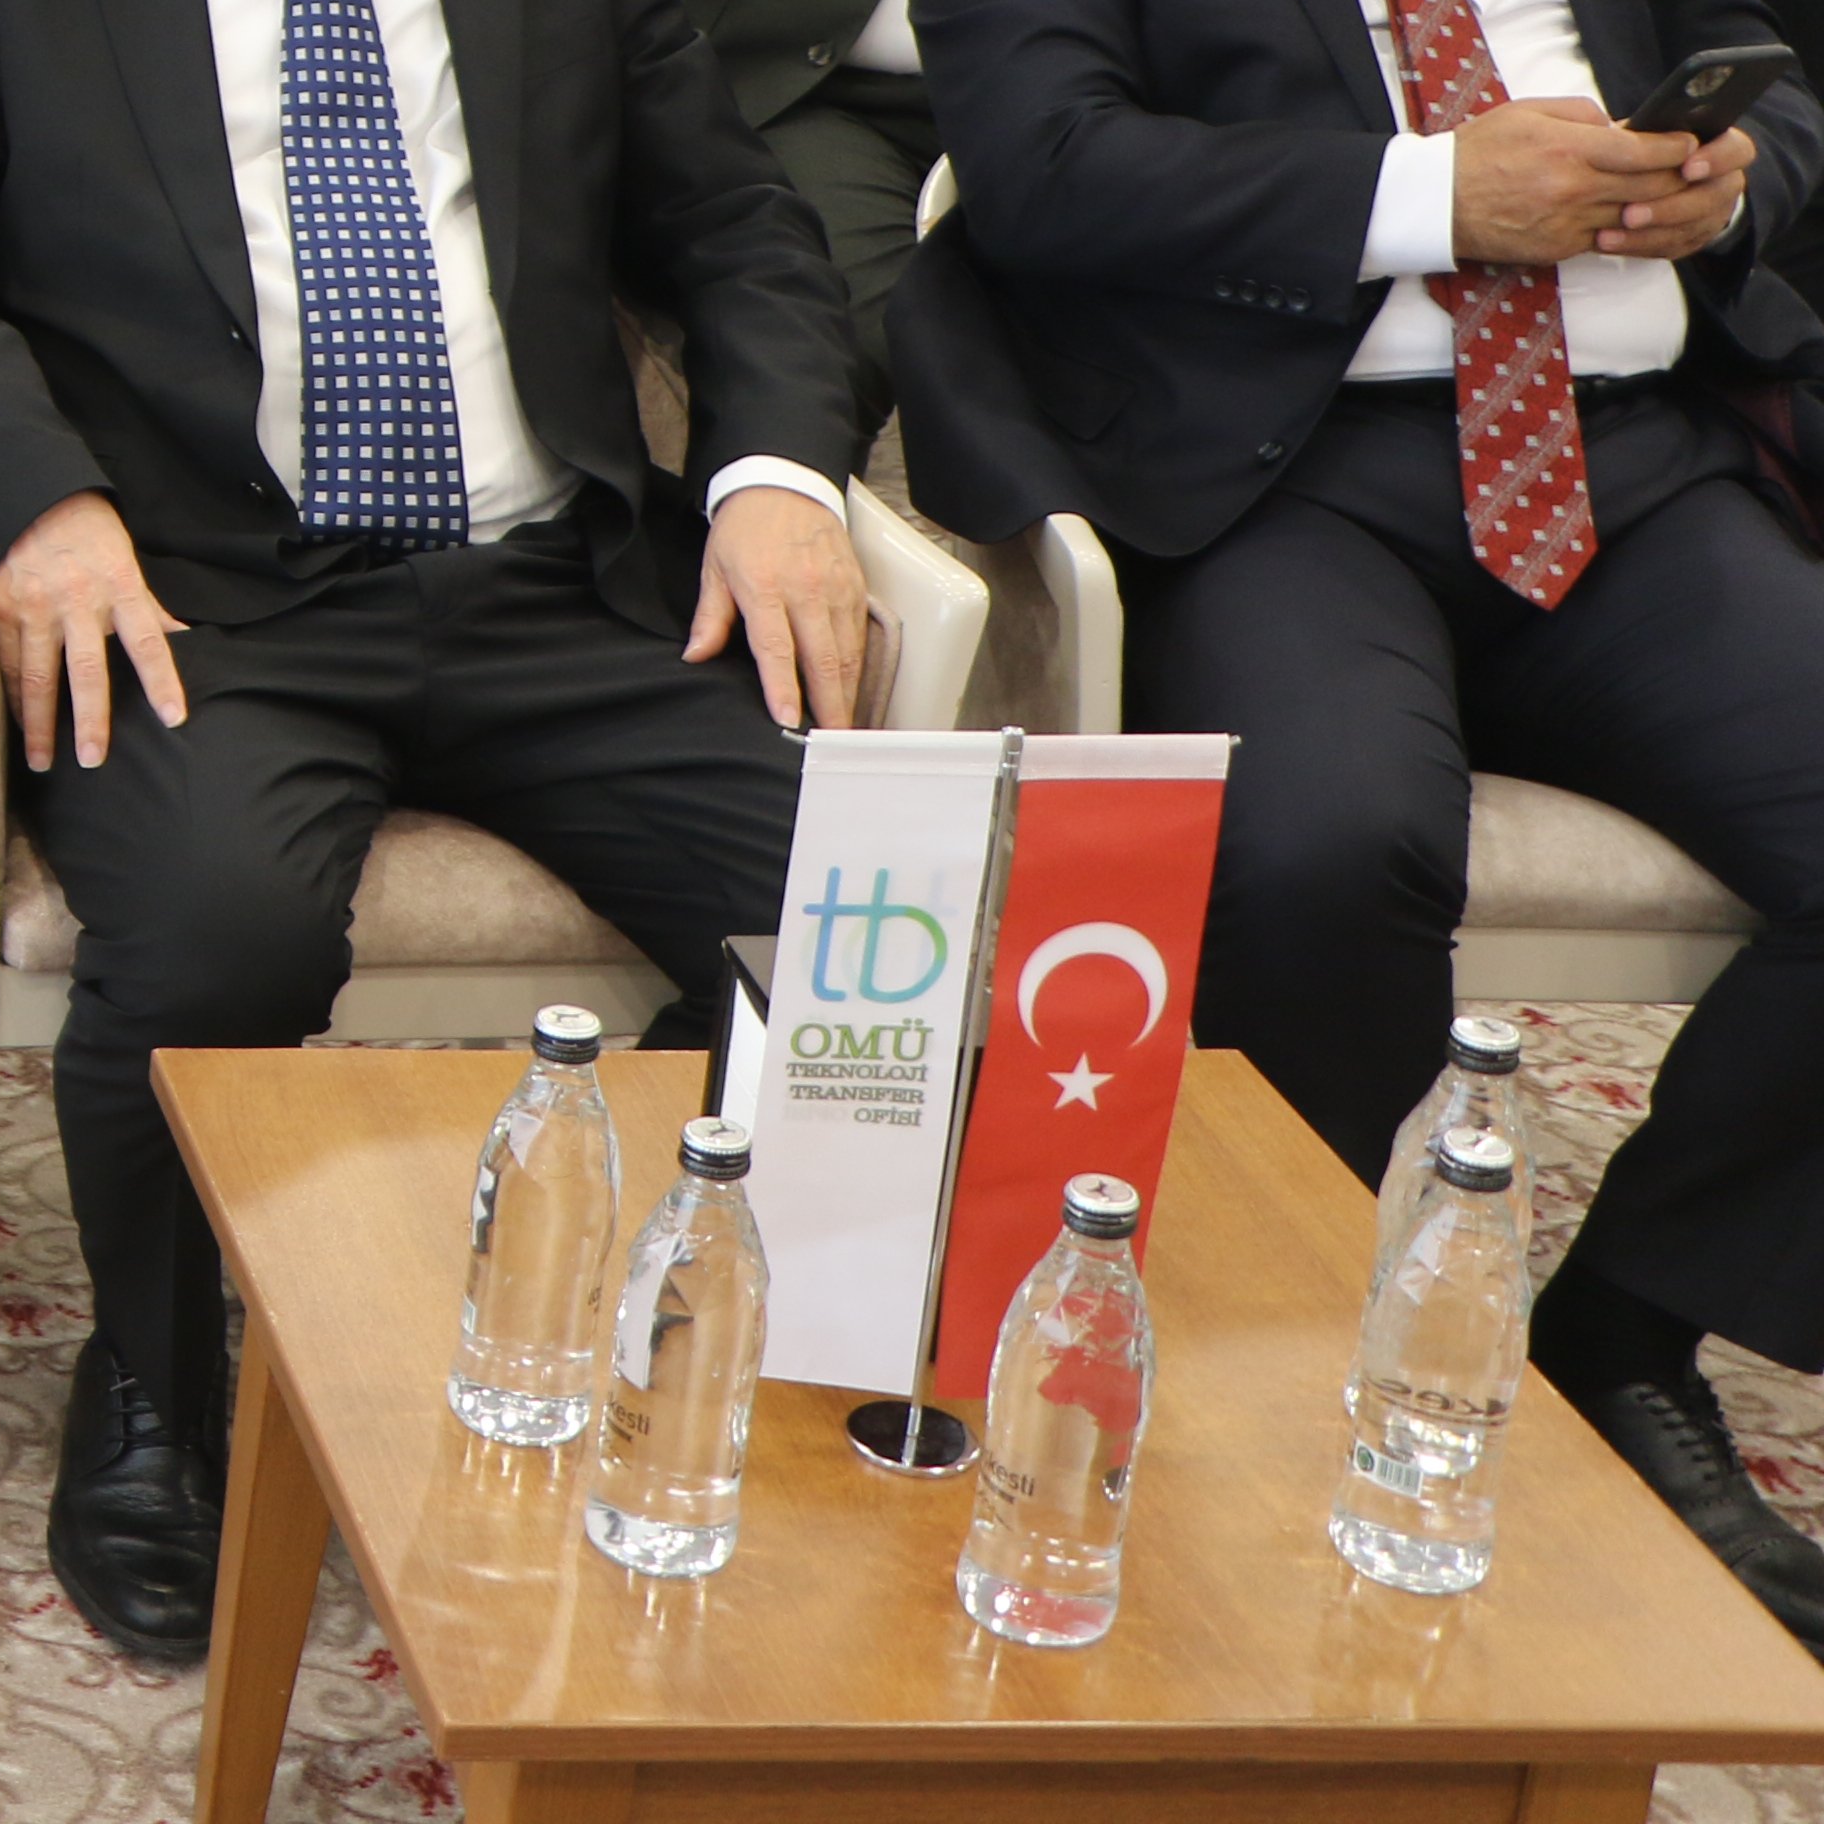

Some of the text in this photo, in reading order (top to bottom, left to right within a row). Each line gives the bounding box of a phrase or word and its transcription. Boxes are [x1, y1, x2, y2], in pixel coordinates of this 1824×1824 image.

[790, 1018, 934, 1062] OMÜ
[786, 1062, 928, 1082] TEKNOLOJİ
[789, 1084, 925, 1105] TRANSFER
[854, 1107, 923, 1127] OFİSİ
